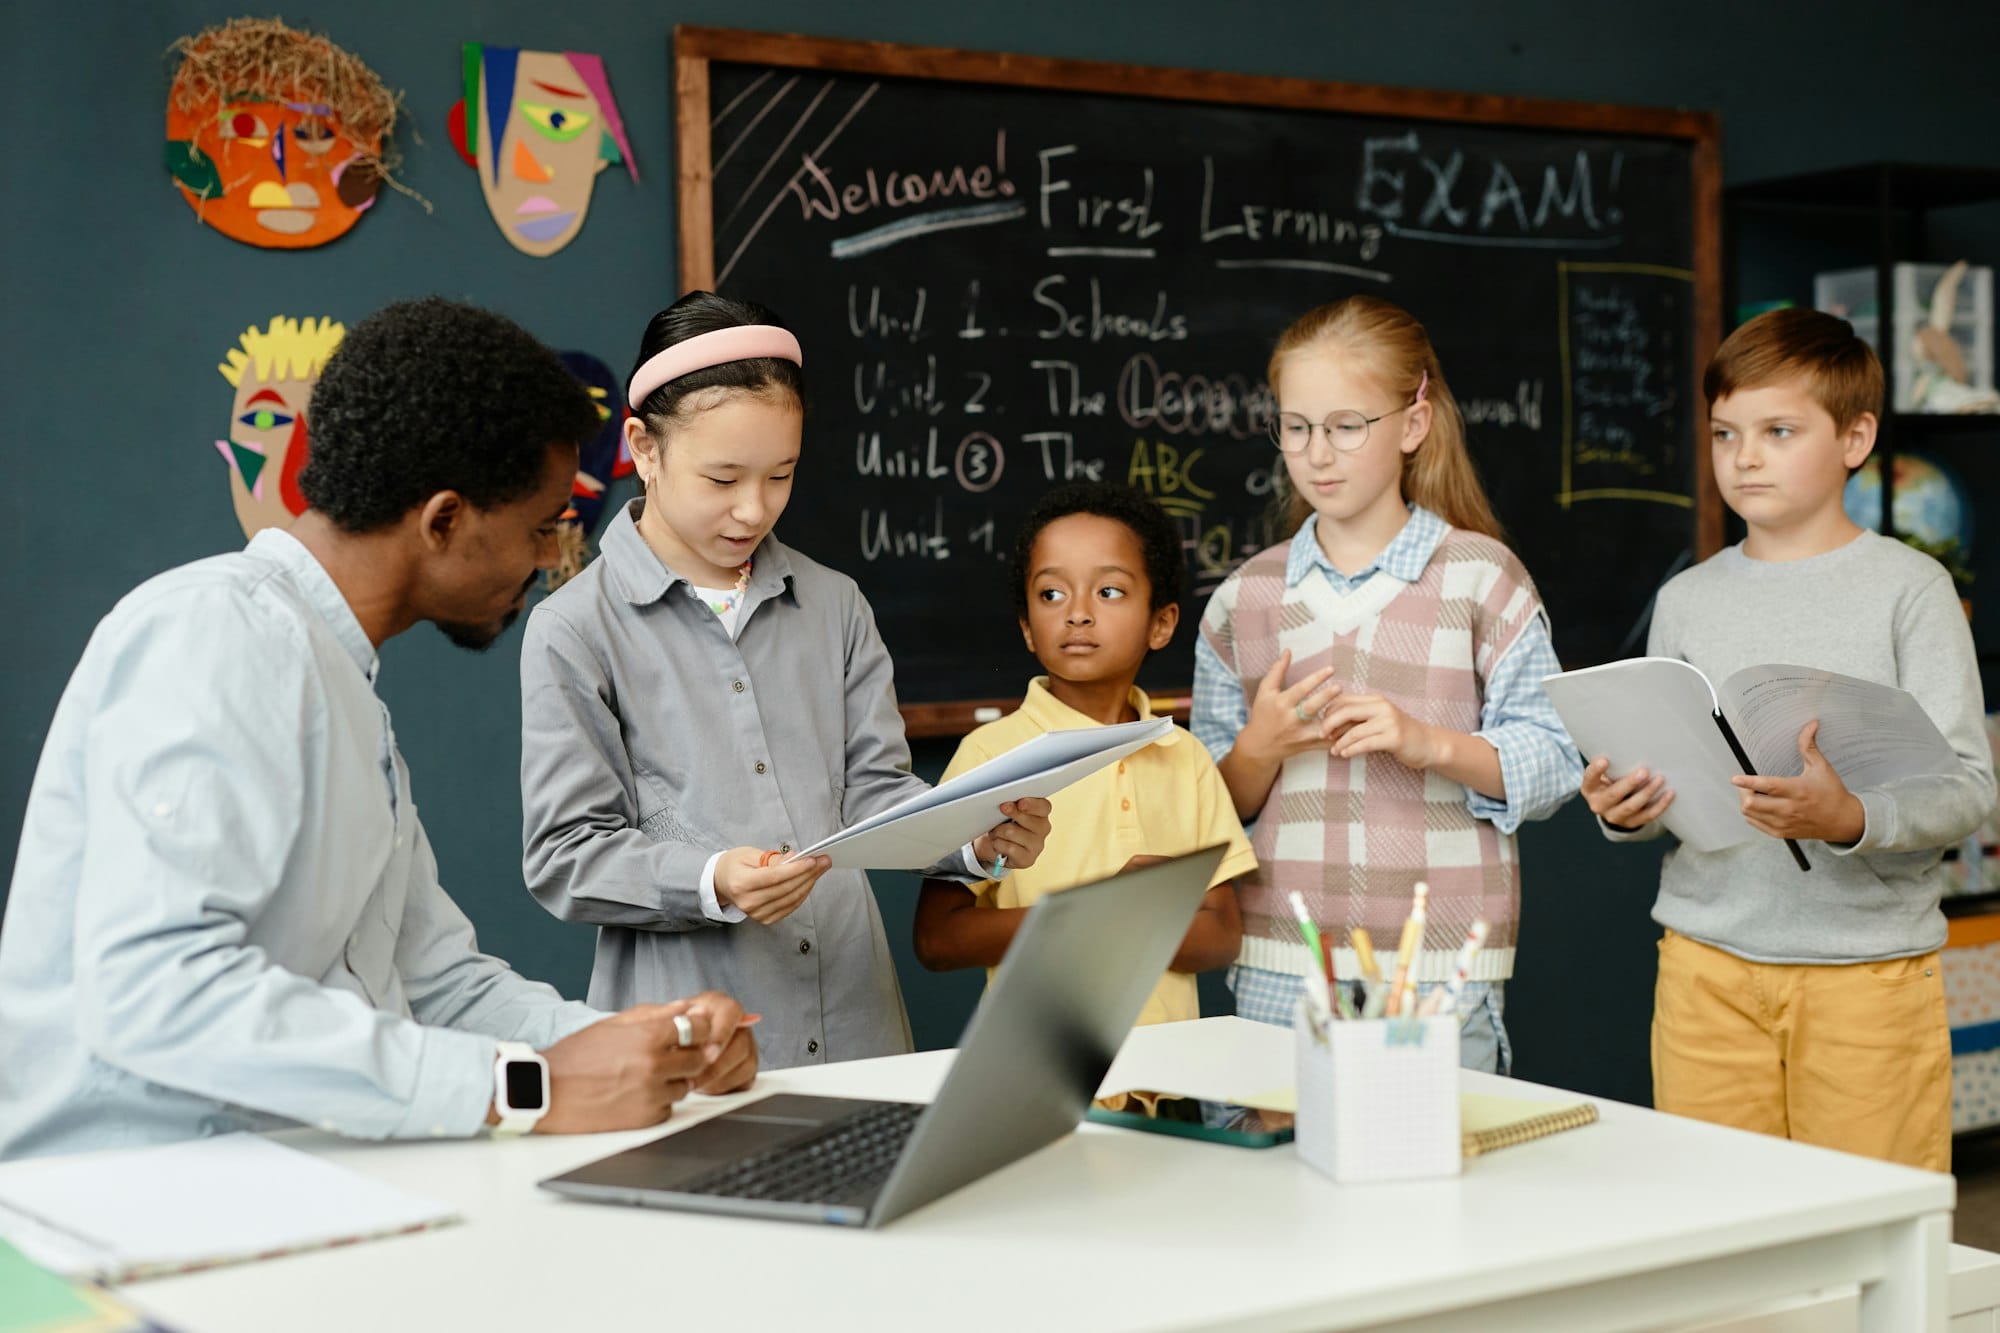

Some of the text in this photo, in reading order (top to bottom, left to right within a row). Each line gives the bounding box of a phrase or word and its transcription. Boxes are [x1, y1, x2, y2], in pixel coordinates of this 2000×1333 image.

[788, 129, 1016, 221] Welcome!
[1038, 145, 1163, 239] First
[1357, 129, 1624, 231] EXAM!
[1033, 274, 1188, 342] Schools
[1030, 359, 1106, 416] The
[856, 426, 949, 480] Unit
[1021, 430, 1106, 482] The
[1128, 437, 1217, 499] ABC
[860, 495, 951, 562] Unit
